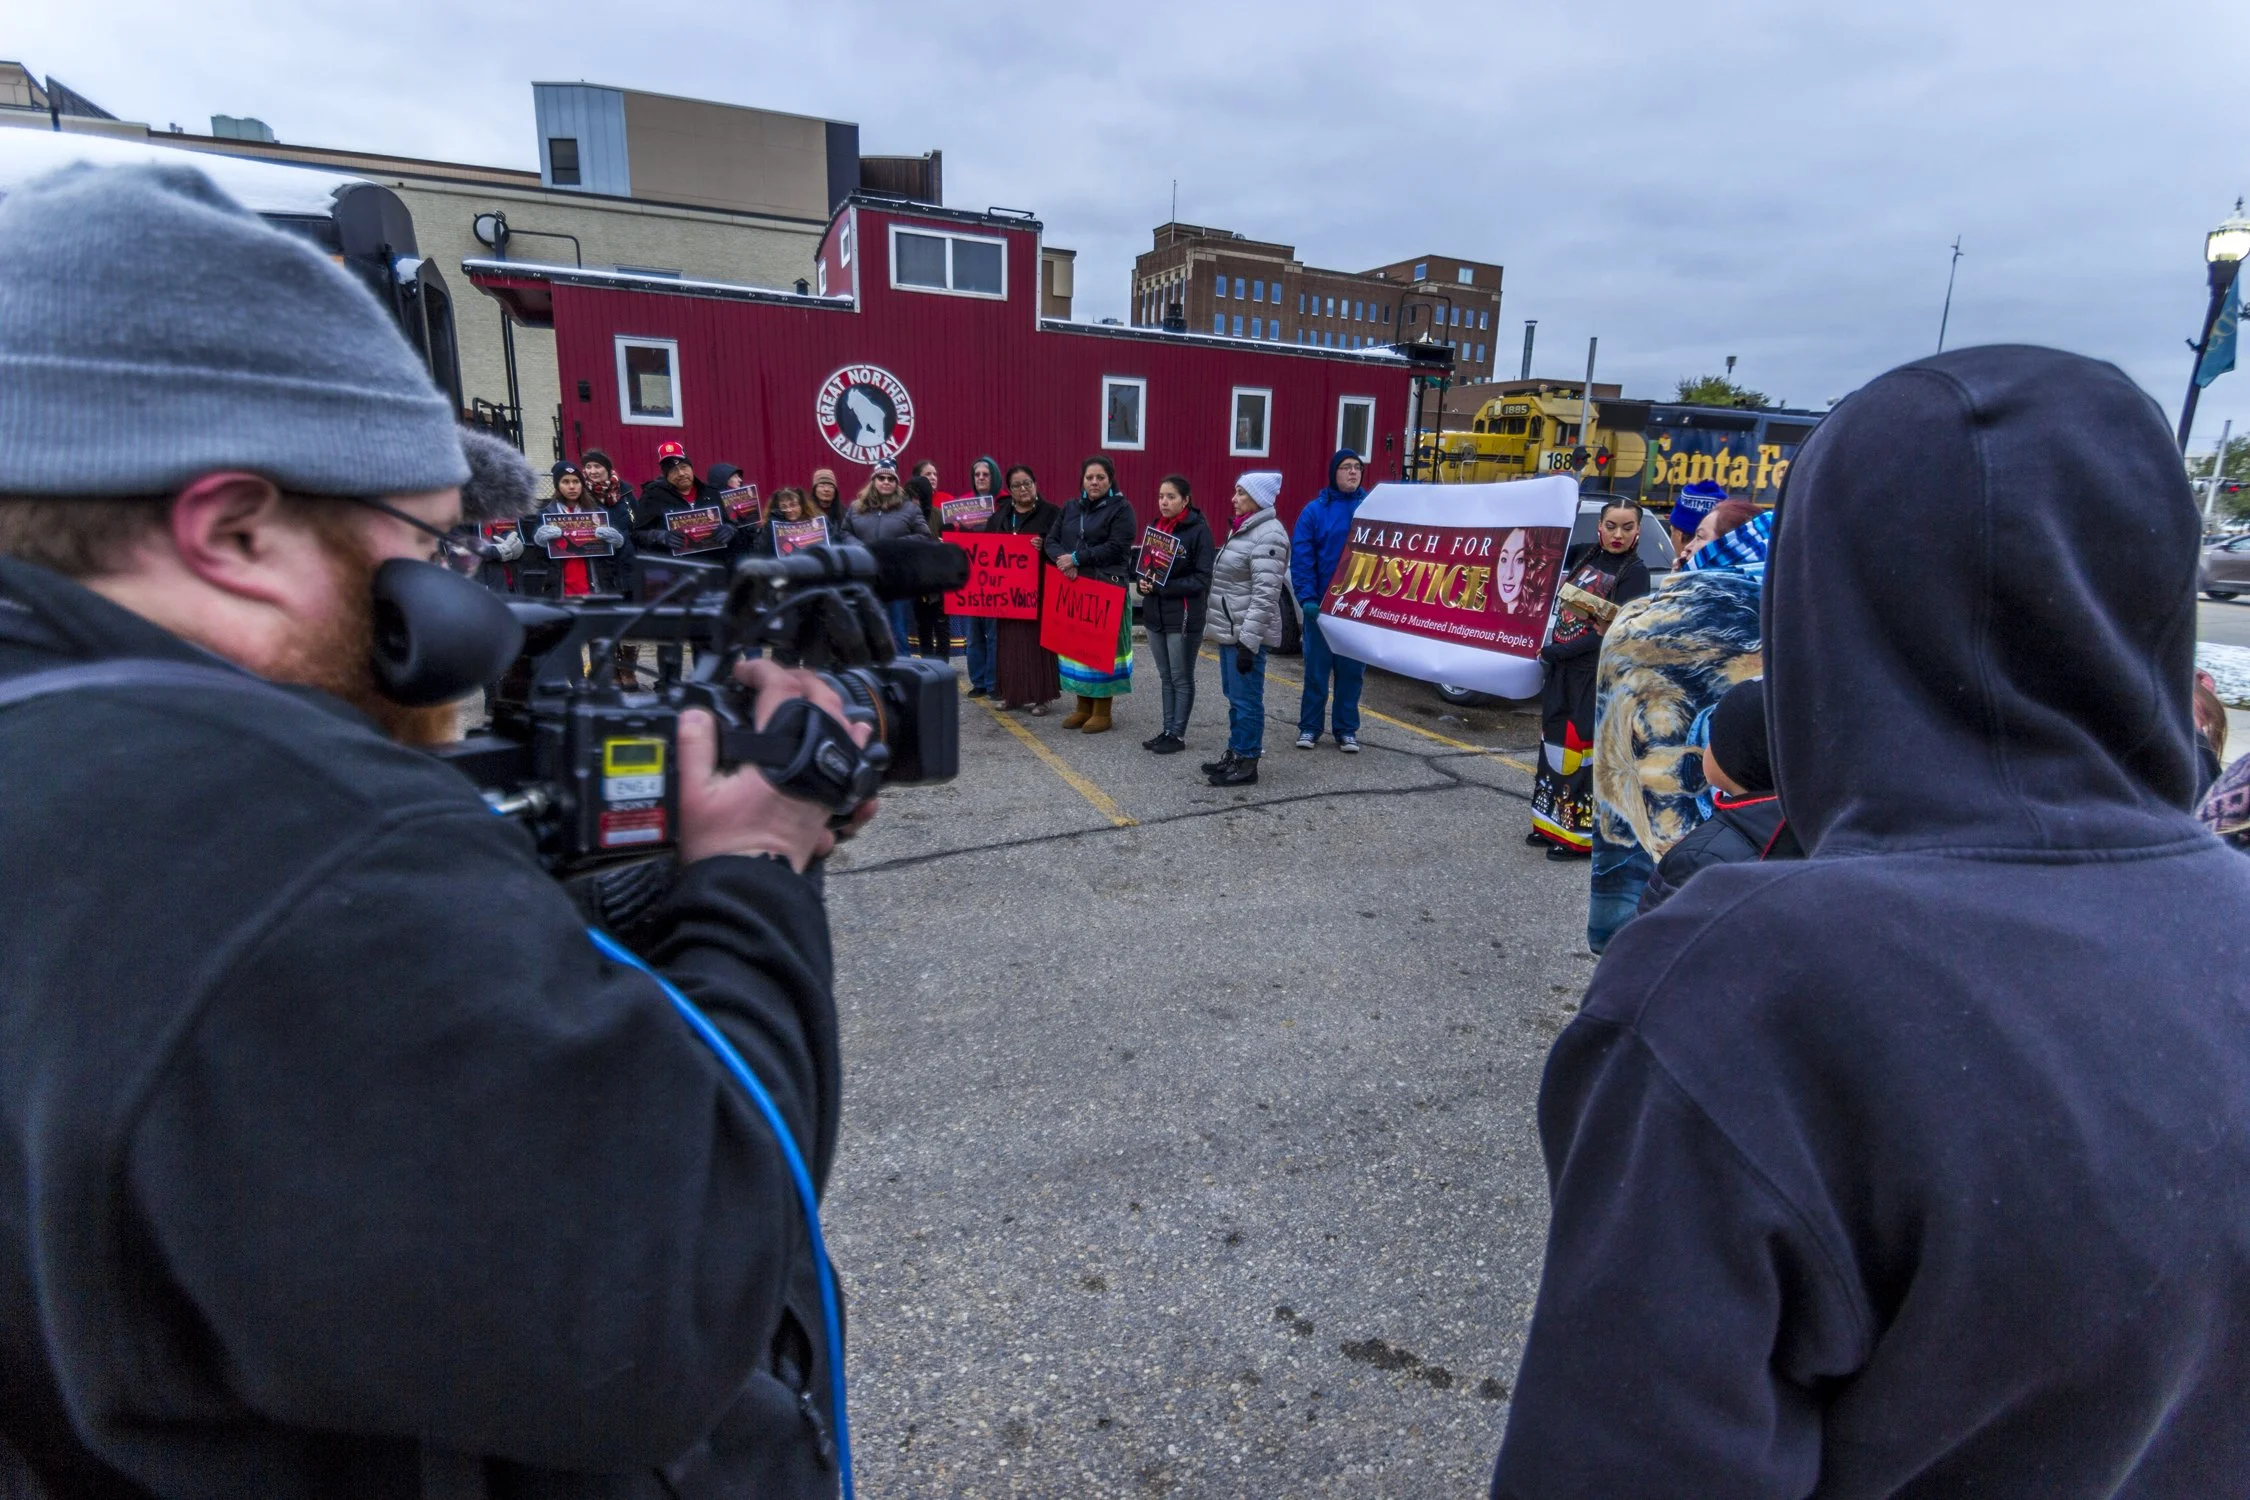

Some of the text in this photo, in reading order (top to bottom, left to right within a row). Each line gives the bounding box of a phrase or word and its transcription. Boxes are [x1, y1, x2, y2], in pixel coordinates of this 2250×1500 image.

[820, 369, 911, 426] GREAT NORTHERN
[1505, 404, 1528, 414] 1885
[832, 433, 900, 461] RAILWAY
[1547, 452, 1573, 470] 188
[1652, 437, 1790, 489] Santa Fe
[1352, 526, 1492, 556] MARCH FOR
[994, 544, 1028, 569] Are
[978, 570, 1007, 588] Our
[1330, 550, 1491, 613] JUSTICE
[955, 588, 1009, 607] Sisters
[1056, 582, 1111, 629] MMIW
[1331, 595, 1534, 648] for All Missing & Murdered Indigenous People's
